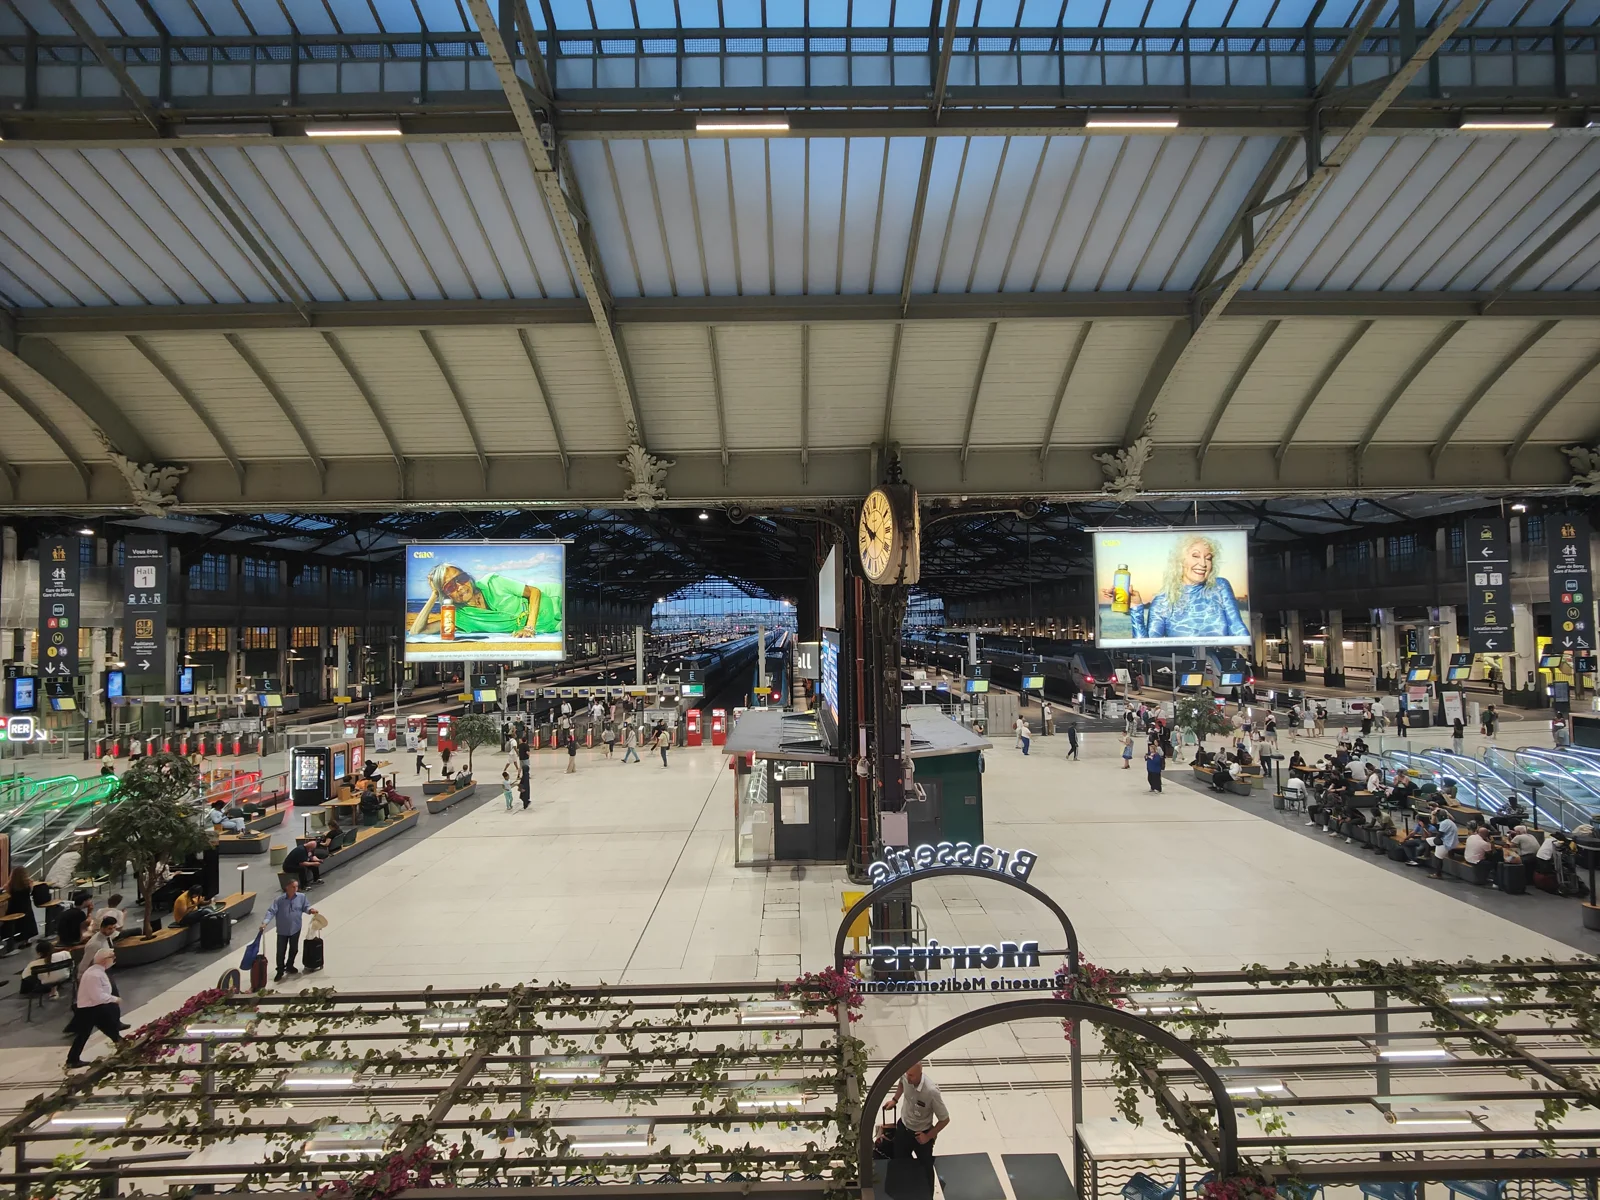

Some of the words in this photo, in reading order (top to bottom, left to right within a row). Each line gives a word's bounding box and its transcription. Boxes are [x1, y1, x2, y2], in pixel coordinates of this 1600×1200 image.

[142, 576, 147, 586] 1
[1485, 592, 1494, 603] P
[12, 724, 30, 733] RER
